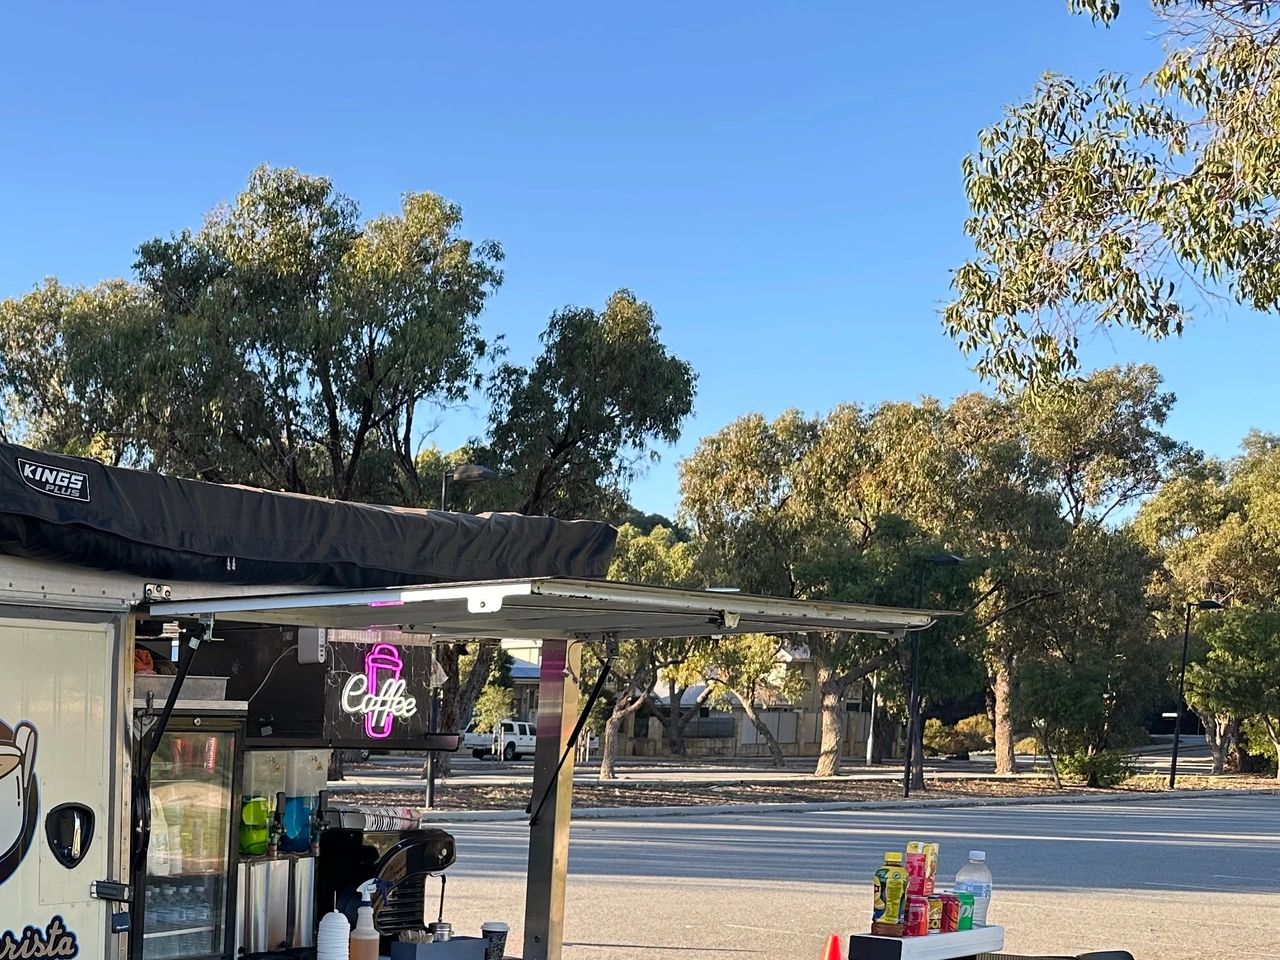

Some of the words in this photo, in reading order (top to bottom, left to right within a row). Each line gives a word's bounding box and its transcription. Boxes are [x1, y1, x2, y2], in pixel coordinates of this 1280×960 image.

[23, 464, 84, 490] KINGS
[45, 484, 81, 498] PLUS
[342, 673, 418, 728] Coffee
